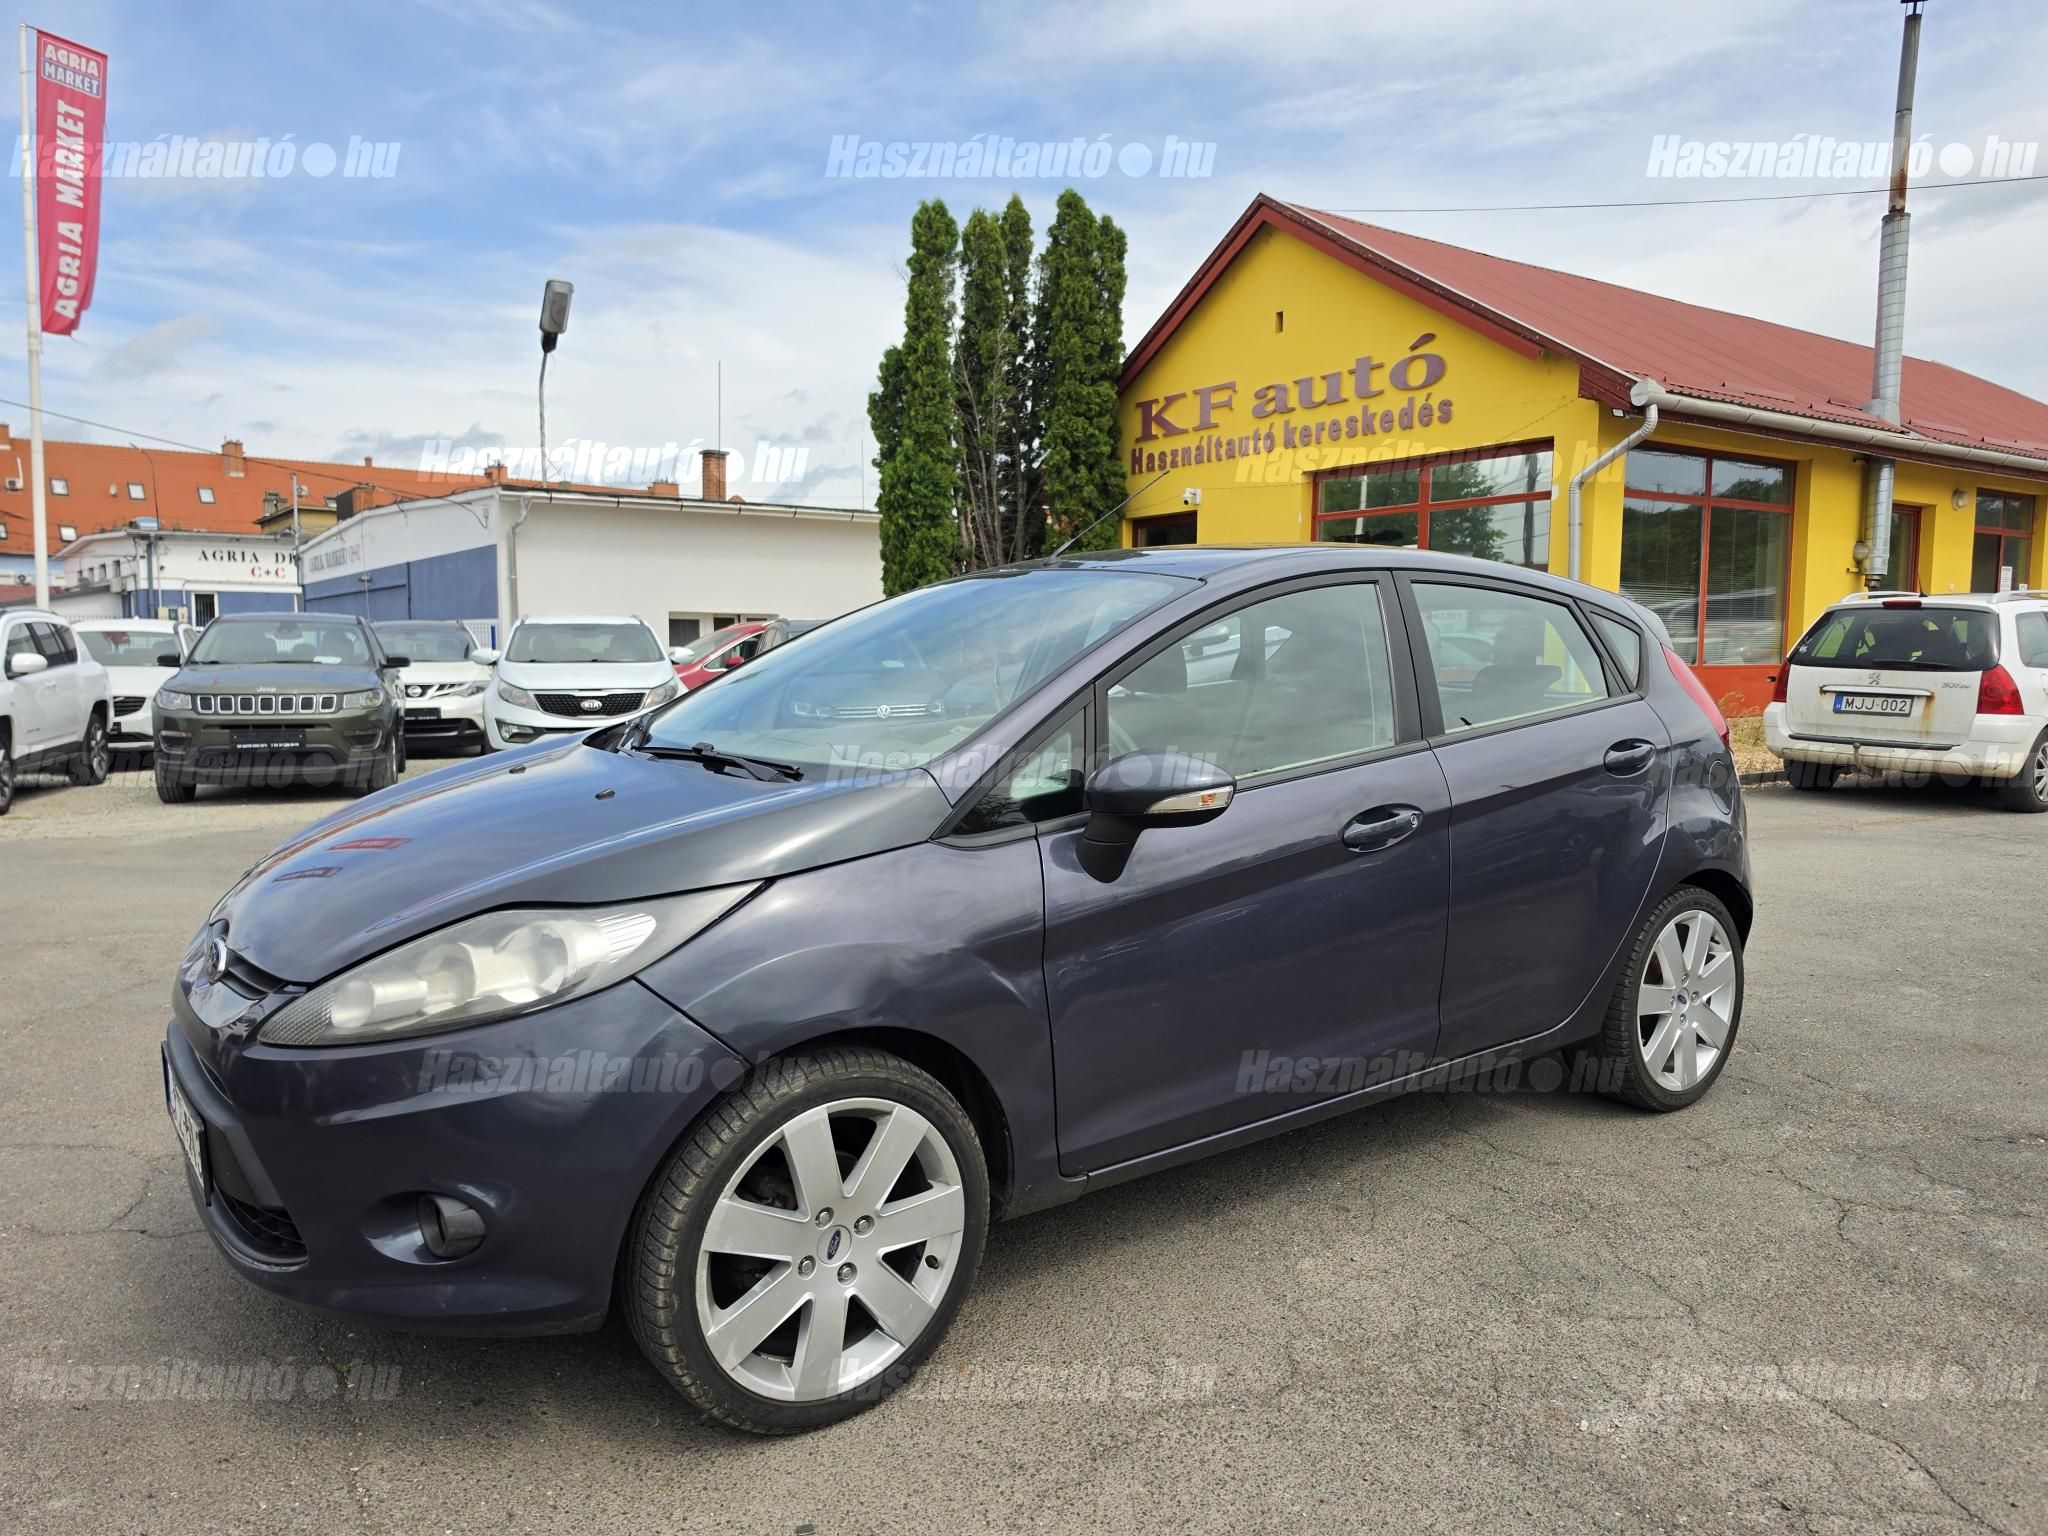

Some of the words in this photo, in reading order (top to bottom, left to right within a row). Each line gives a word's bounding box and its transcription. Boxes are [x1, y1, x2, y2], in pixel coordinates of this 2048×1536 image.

[43, 62, 100, 95] MARKET
[44, 43, 99, 77] AGRIA
[56, 99, 85, 209] MARKET
[54, 221, 83, 320] AGRIA
[1134, 381, 1237, 443] KF
[1252, 333, 1446, 419] autó
[1130, 423, 1275, 475] Használtautó
[1284, 394, 1454, 447] kereskedés
[199, 549, 260, 563] AGRIA
[1845, 698, 1907, 712] MJJ-002
